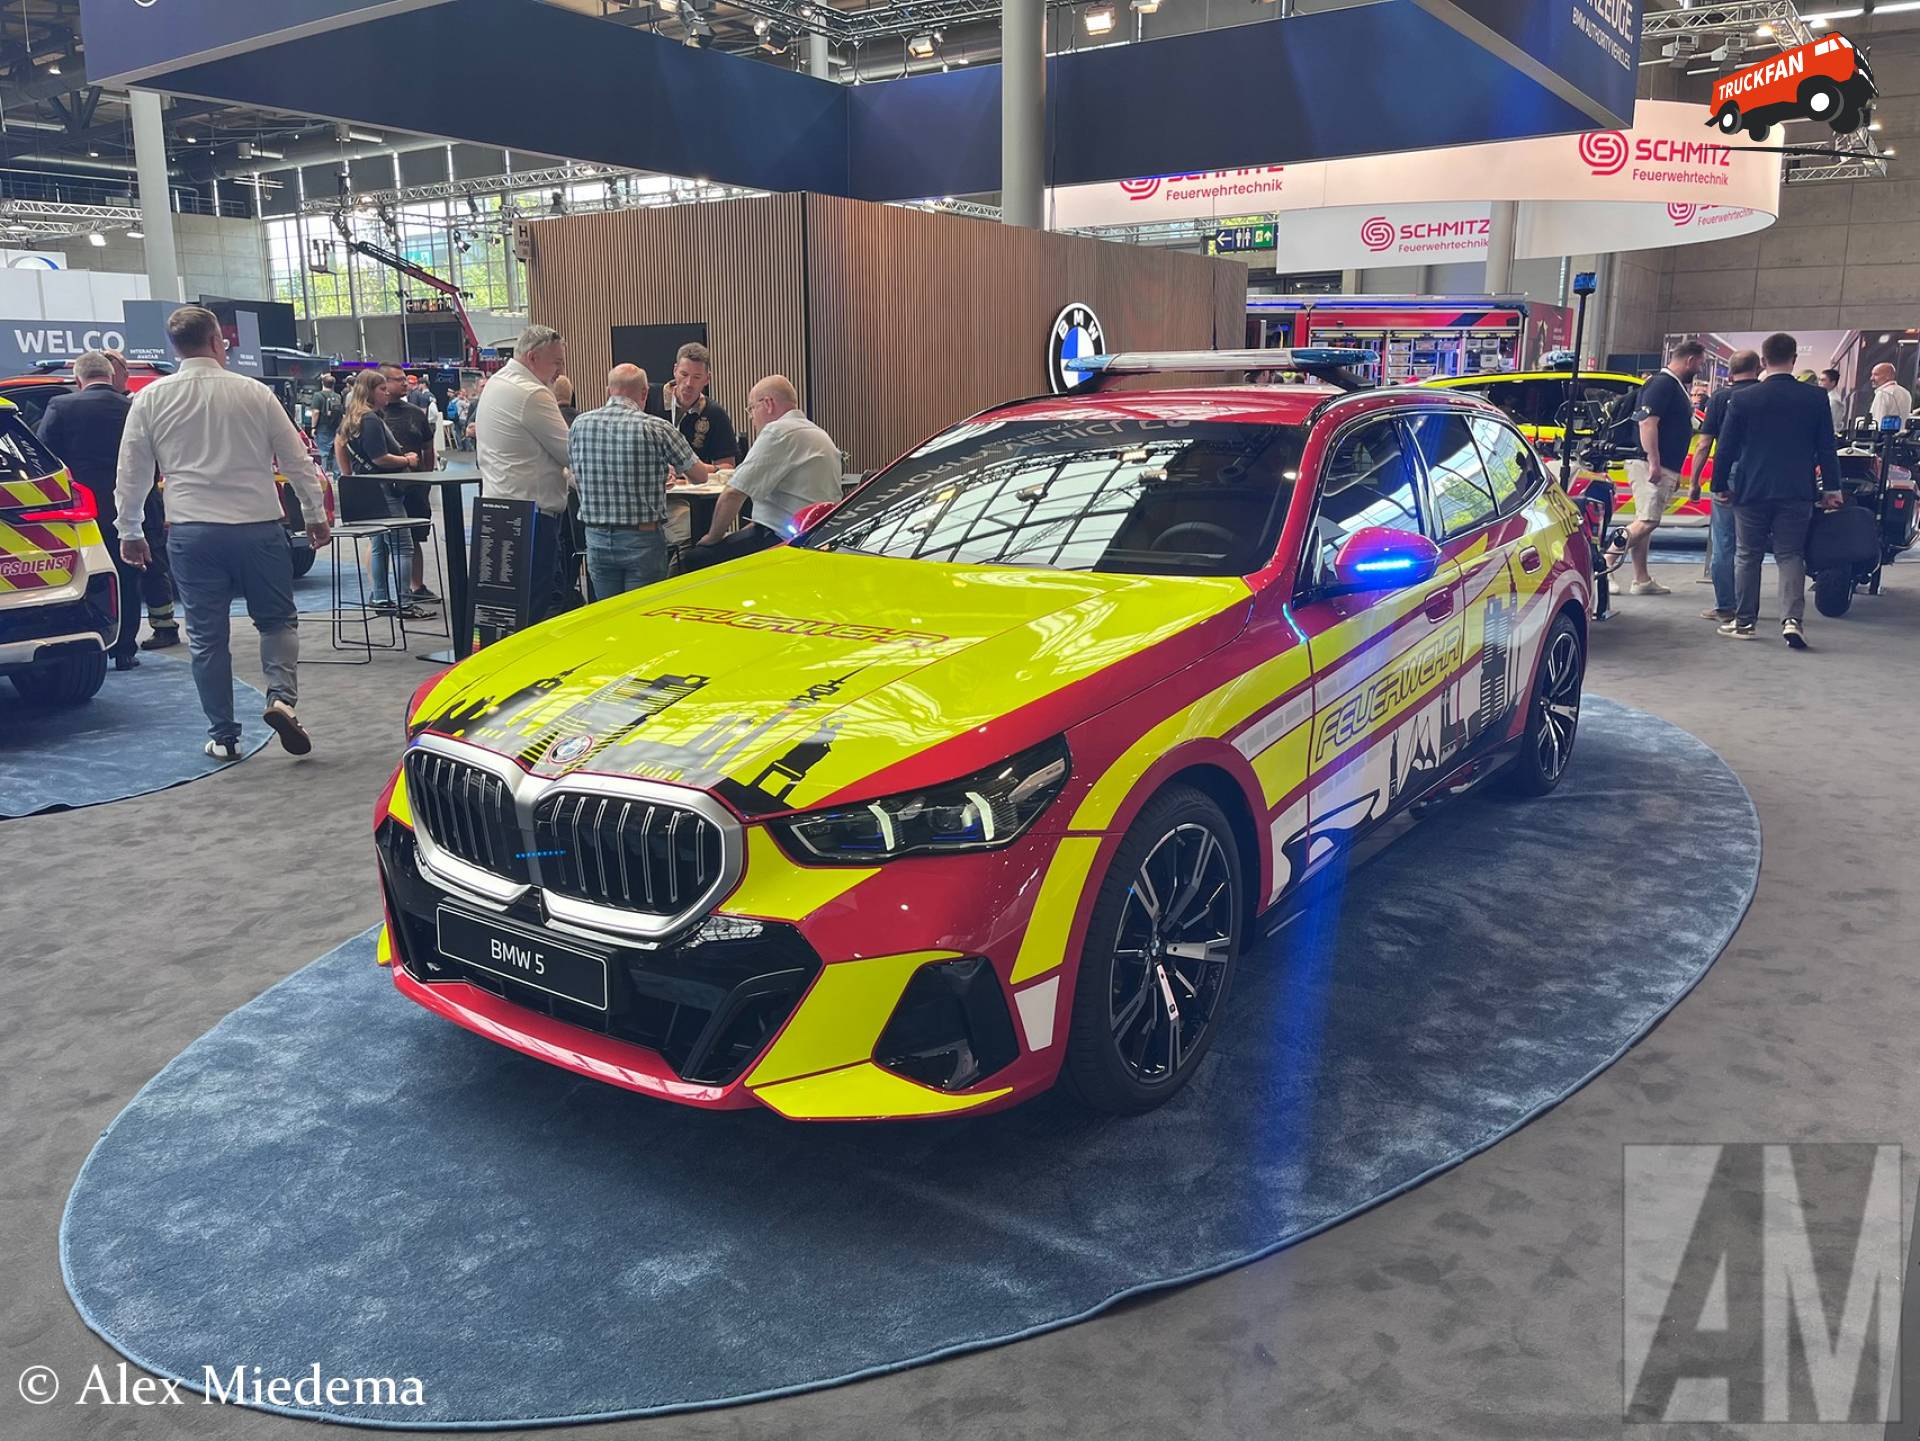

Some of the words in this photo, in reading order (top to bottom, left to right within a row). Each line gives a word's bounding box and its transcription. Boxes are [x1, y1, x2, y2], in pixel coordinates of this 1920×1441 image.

[1635, 139, 1730, 167] SCHMITZ
[1632, 168, 1728, 186] Feuerwehrtechnik
[1166, 179, 1283, 201] Feuerwehrtechnik
[1400, 219, 1490, 240] SCHMITZ
[1399, 240, 1489, 253] Feuerwehrtechnik
[1057, 309, 1099, 341] BMW
[14, 329, 125, 354] WELCO
[0, 555, 73, 576] GSDIENST
[640, 606, 949, 648] FEUERWEHR
[1315, 625, 1461, 763] FEUERWEHR
[491, 938, 531, 970] BMW
[535, 953, 545, 975] 5
